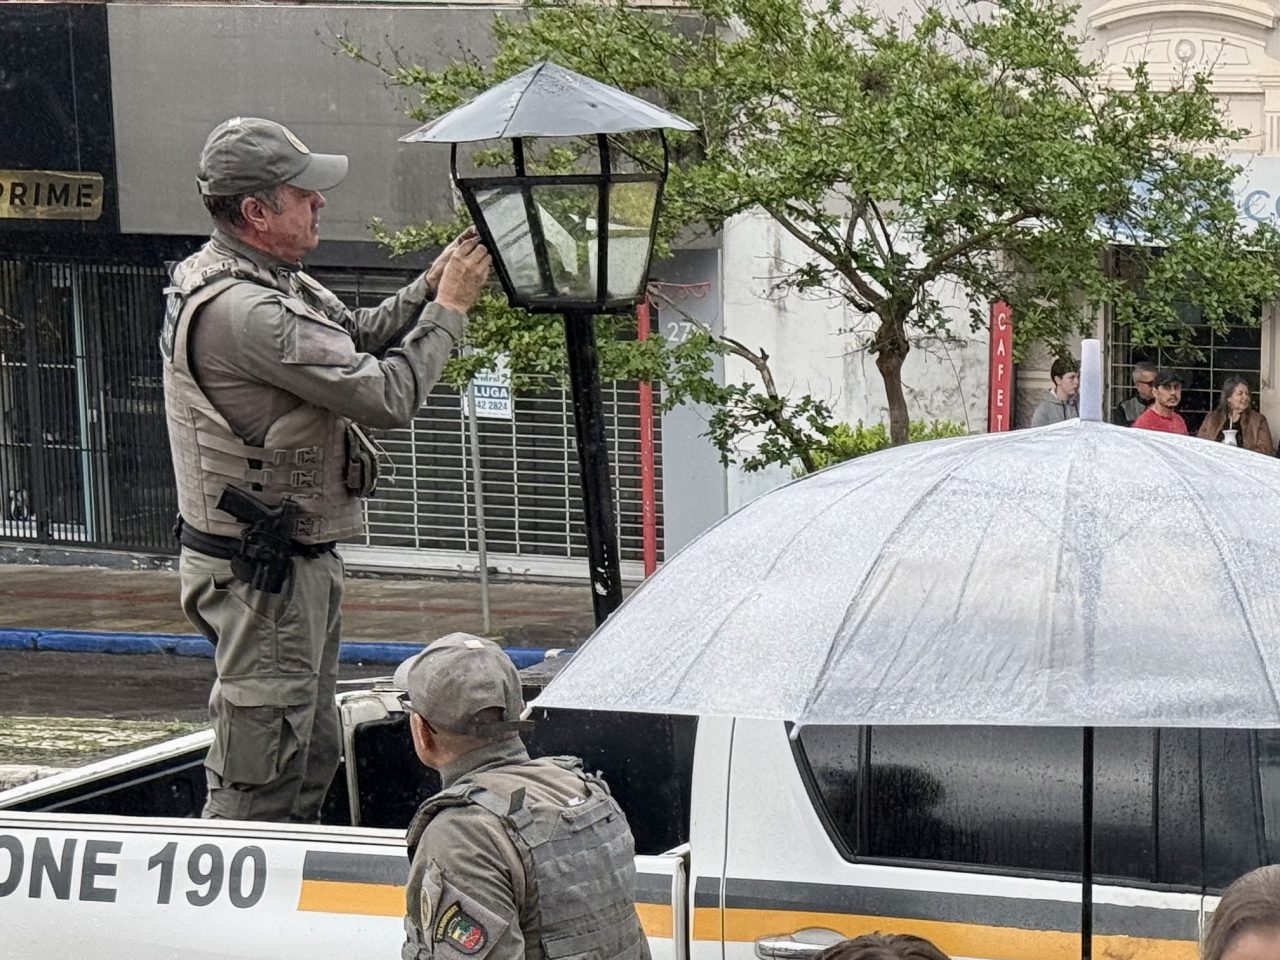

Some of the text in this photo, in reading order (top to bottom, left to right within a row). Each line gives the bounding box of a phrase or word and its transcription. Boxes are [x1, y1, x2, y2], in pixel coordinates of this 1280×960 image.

[0, 182, 94, 208] RIME
[667, 322, 712, 342] 27
[474, 386, 508, 398] LUGA
[148, 841, 267, 909] 190
